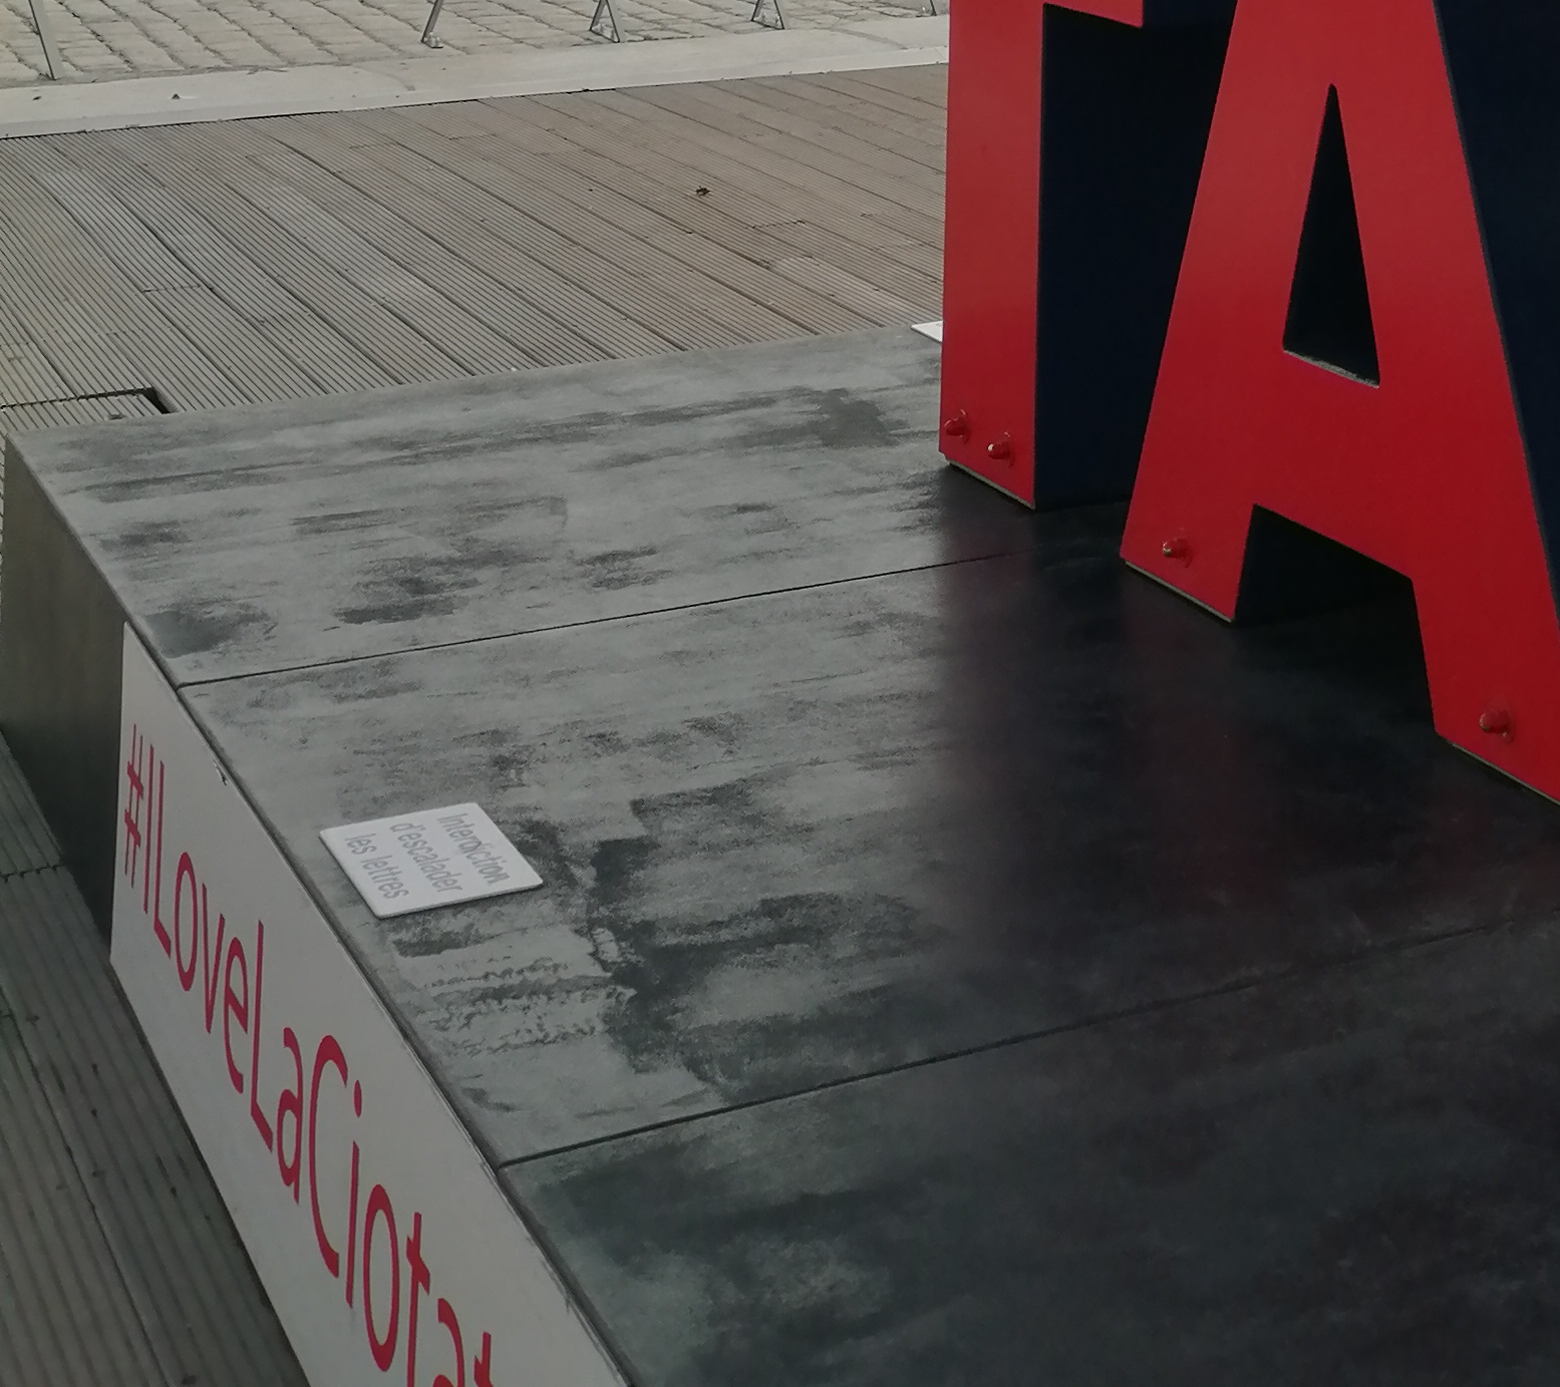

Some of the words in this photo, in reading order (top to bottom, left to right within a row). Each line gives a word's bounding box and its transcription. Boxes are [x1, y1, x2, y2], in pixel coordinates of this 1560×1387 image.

[344, 833, 377, 855] les
[361, 855, 410, 900] lettres
[389, 822, 463, 894] d'escalader
[437, 812, 511, 885] Interdiction
[124, 724, 495, 1387] #ILoveLaCiot
